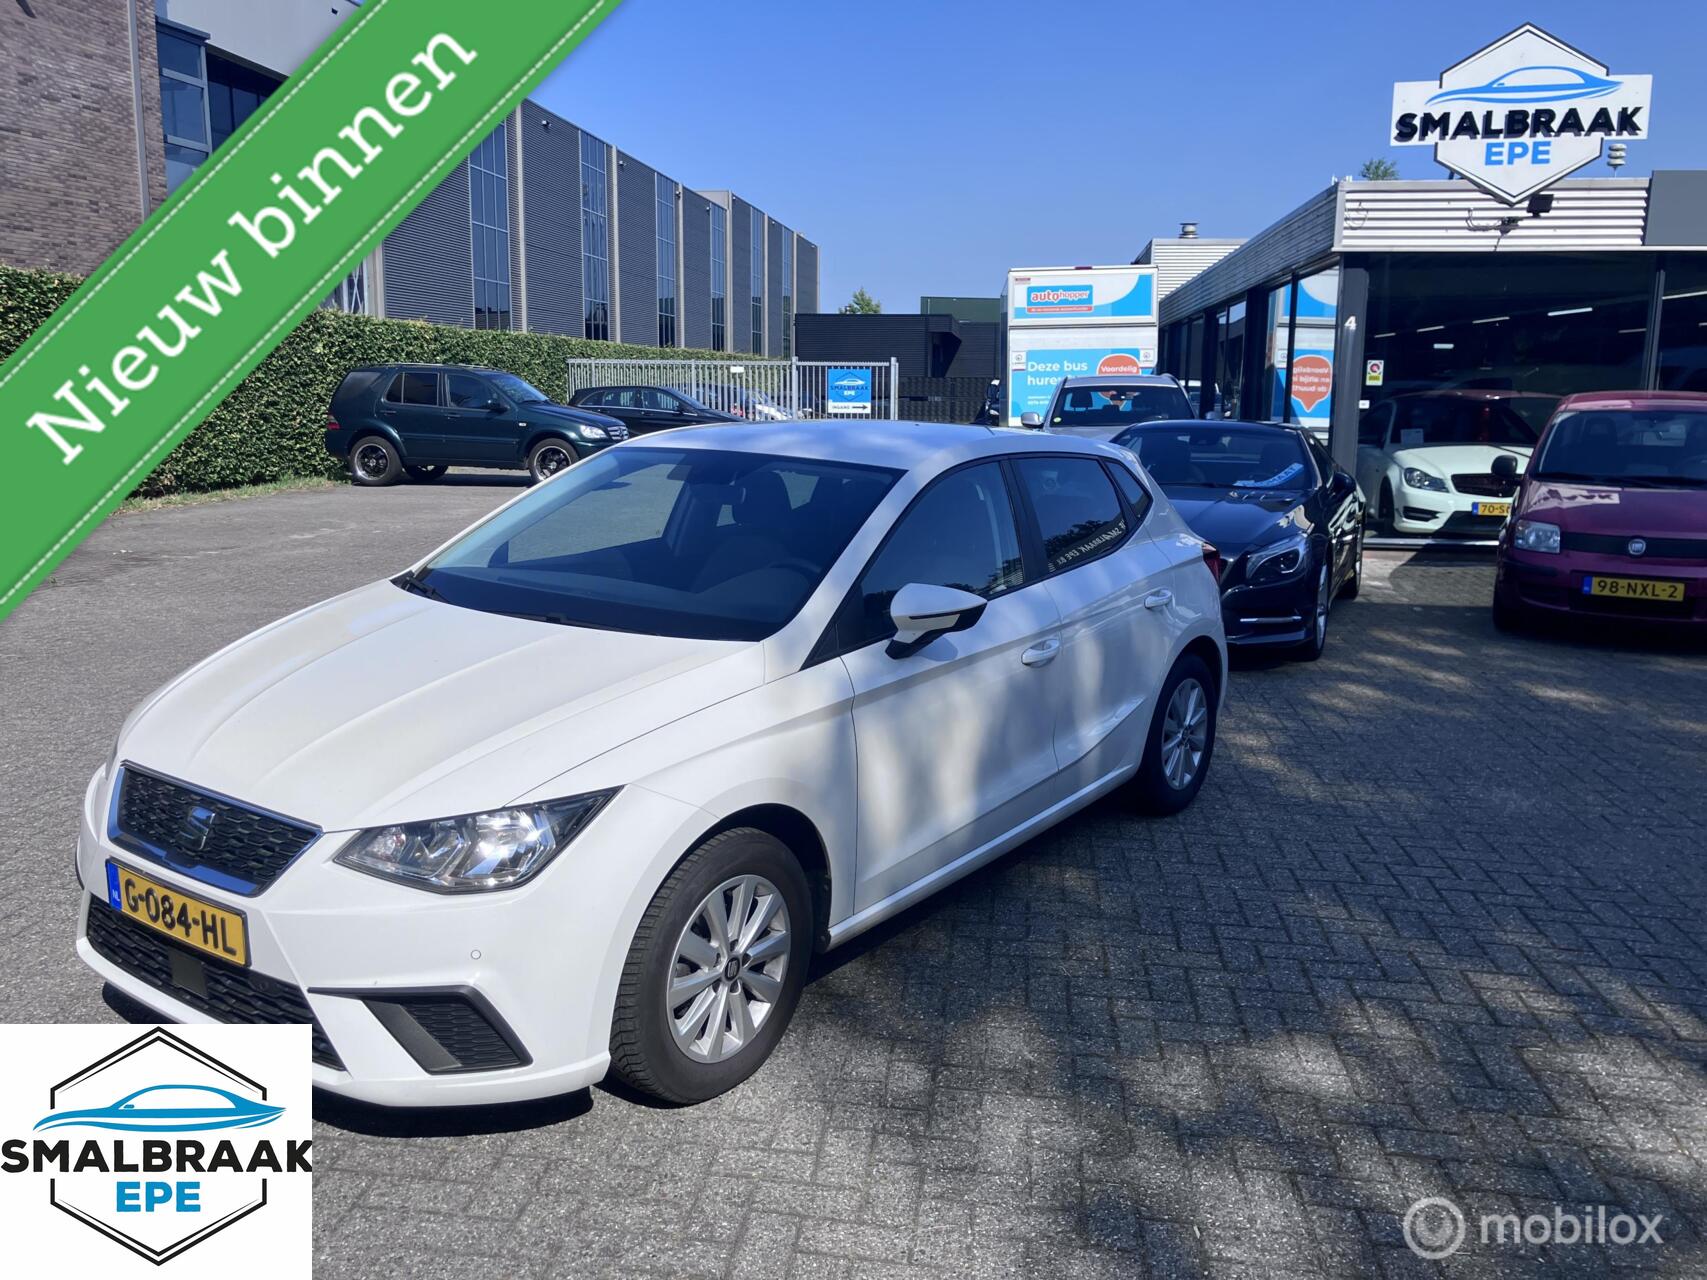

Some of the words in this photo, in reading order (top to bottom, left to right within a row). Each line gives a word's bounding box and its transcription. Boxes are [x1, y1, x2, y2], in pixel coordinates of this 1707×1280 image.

[1393, 106, 1644, 142] SMALBRAAK
[1484, 141, 1552, 166] EPE
[1031, 290, 1089, 303] autohopper
[1344, 315, 1357, 330] 4
[1027, 361, 1060, 372] Deze
[1064, 360, 1088, 371] bus
[1101, 366, 1137, 374] Voordelig
[1597, 579, 1678, 599] 98-NXL-2
[124, 877, 237, 956] G-084-HL
